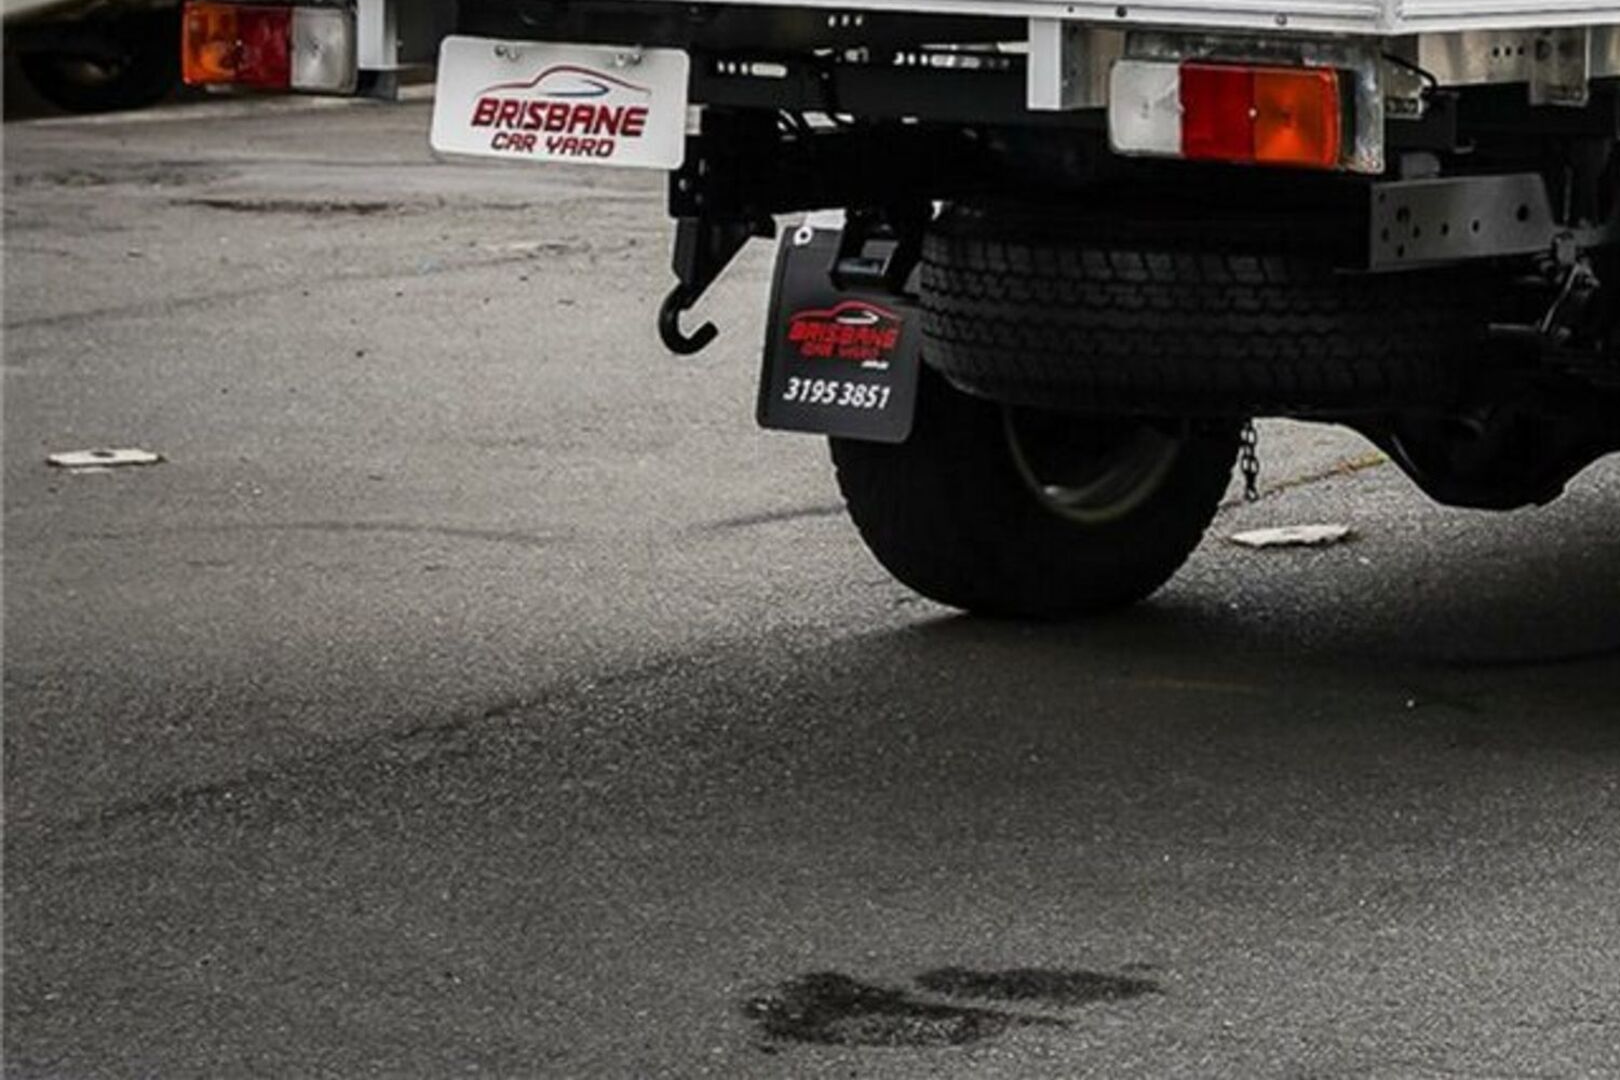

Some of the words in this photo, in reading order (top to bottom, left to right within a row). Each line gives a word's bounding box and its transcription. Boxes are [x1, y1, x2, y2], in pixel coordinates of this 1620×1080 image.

[471, 98, 649, 136] BRISBANE
[491, 133, 537, 153] CAR
[546, 135, 615, 158] YARD
[783, 377, 839, 404] 3195
[837, 382, 891, 410] 3851
